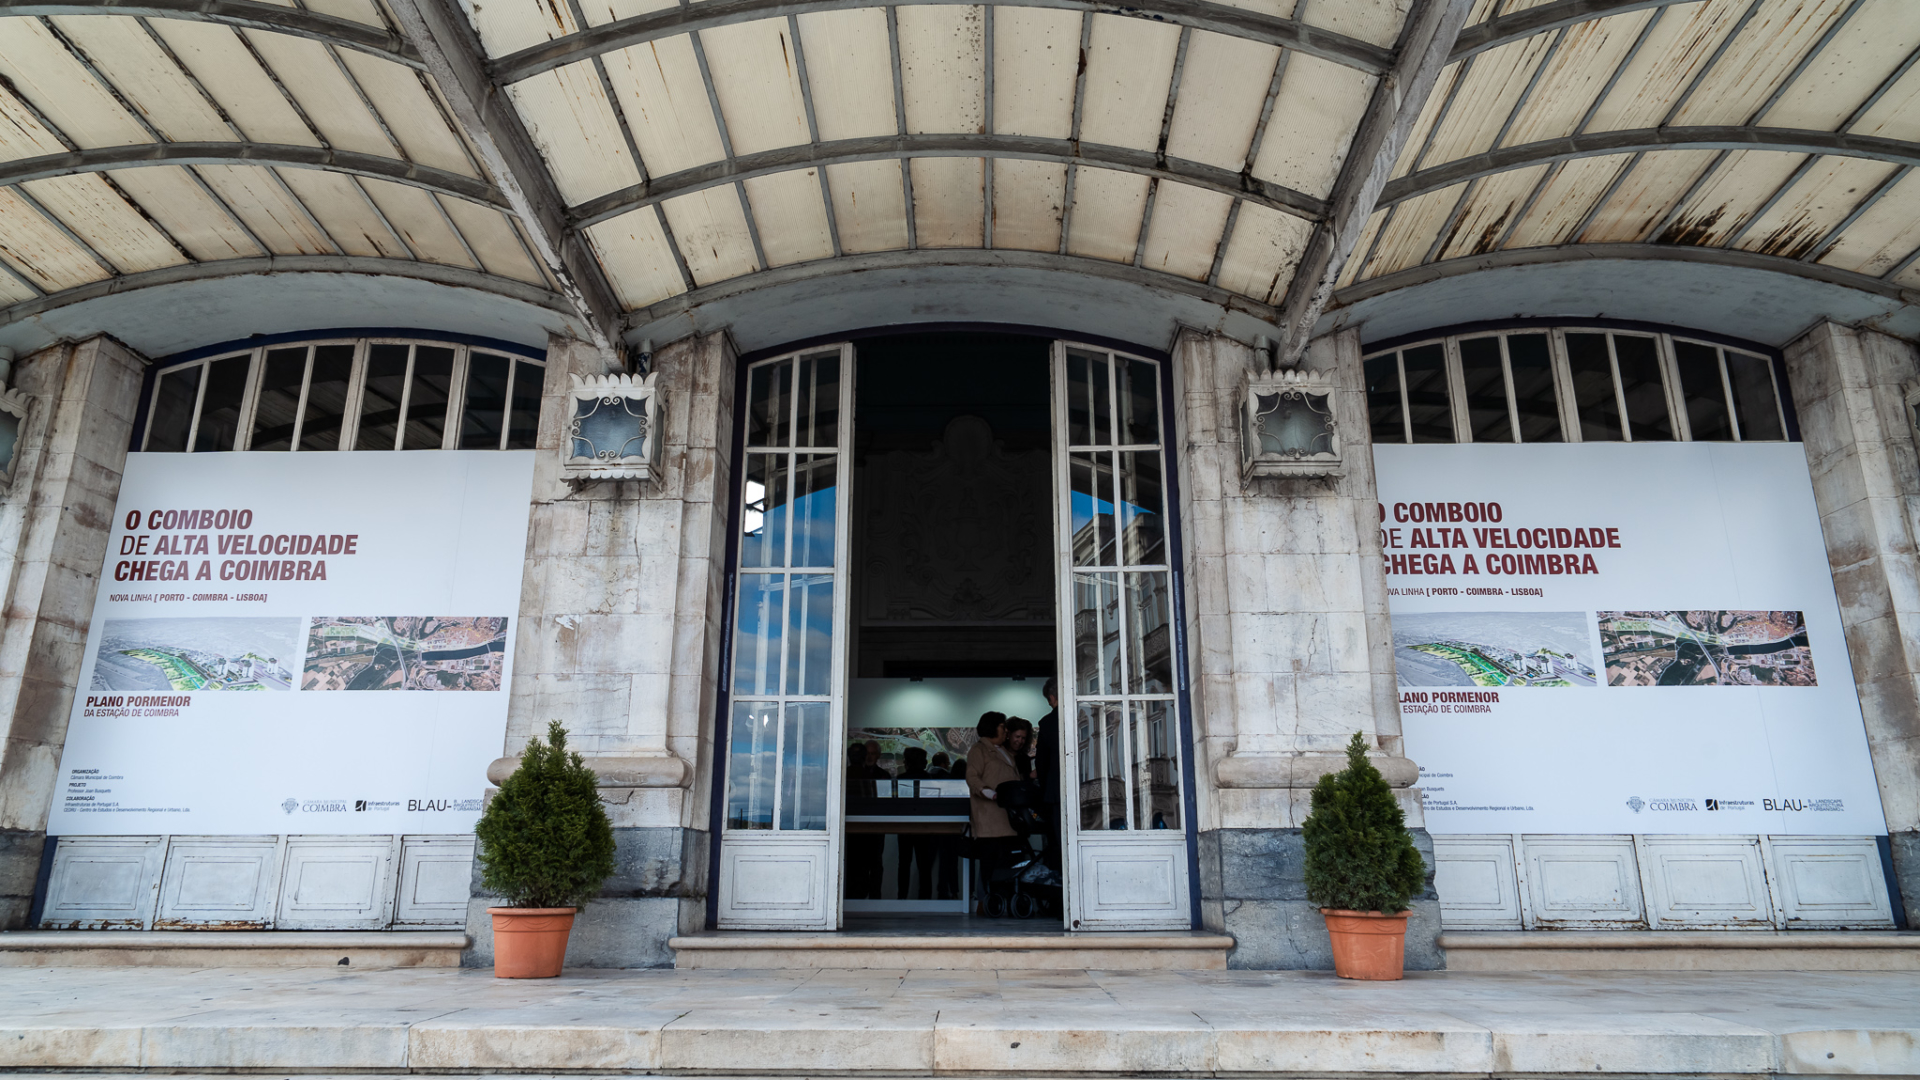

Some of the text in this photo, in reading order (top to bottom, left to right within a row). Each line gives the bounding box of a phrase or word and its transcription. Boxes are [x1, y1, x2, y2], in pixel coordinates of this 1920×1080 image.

[125, 509, 252, 530] O COMBOIO
[1394, 502, 1502, 523] COMBOIO
[120, 534, 358, 555] DE ALTA VELOCIDADE
[1410, 528, 1469, 548] ALTA
[1473, 527, 1621, 549] VELOCIDADE
[114, 560, 326, 581] CHEGA A COIMBRA
[1463, 554, 1480, 574] A
[1486, 553, 1599, 575] COIMBRA
[86, 696, 191, 707] PLANO PORMENOR
[1432, 692, 1500, 702] PORMENOR
[96, 707, 129, 719] ESTAÇÃO
[1403, 704, 1438, 715] ESTAÇÃO
[1454, 705, 1491, 713] COIMBRA
[302, 804, 346, 812] COIMBRA
[1650, 803, 1698, 811] COIMBRA
